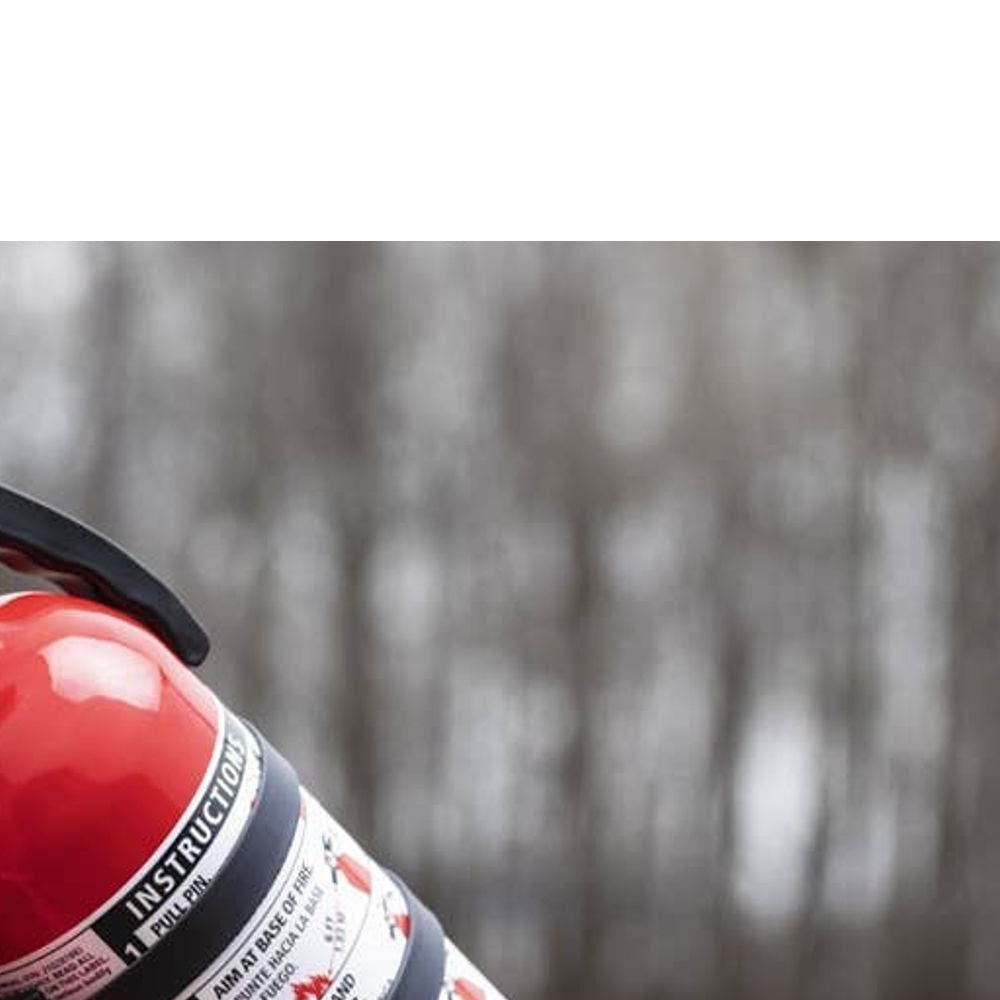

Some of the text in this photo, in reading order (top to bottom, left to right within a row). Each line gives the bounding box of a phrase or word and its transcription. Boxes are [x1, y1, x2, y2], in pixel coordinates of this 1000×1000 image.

[125, 733, 245, 921] INSTRUCTIONS
[125, 873, 212, 959] 1 PULL PIN.
[212, 967, 243, 1000] AIM
[240, 950, 259, 973] AT
[256, 913, 287, 954] BASE
[281, 891, 299, 915] OF
[270, 931, 300, 971] HACIA
[298, 914, 310, 935] LA
